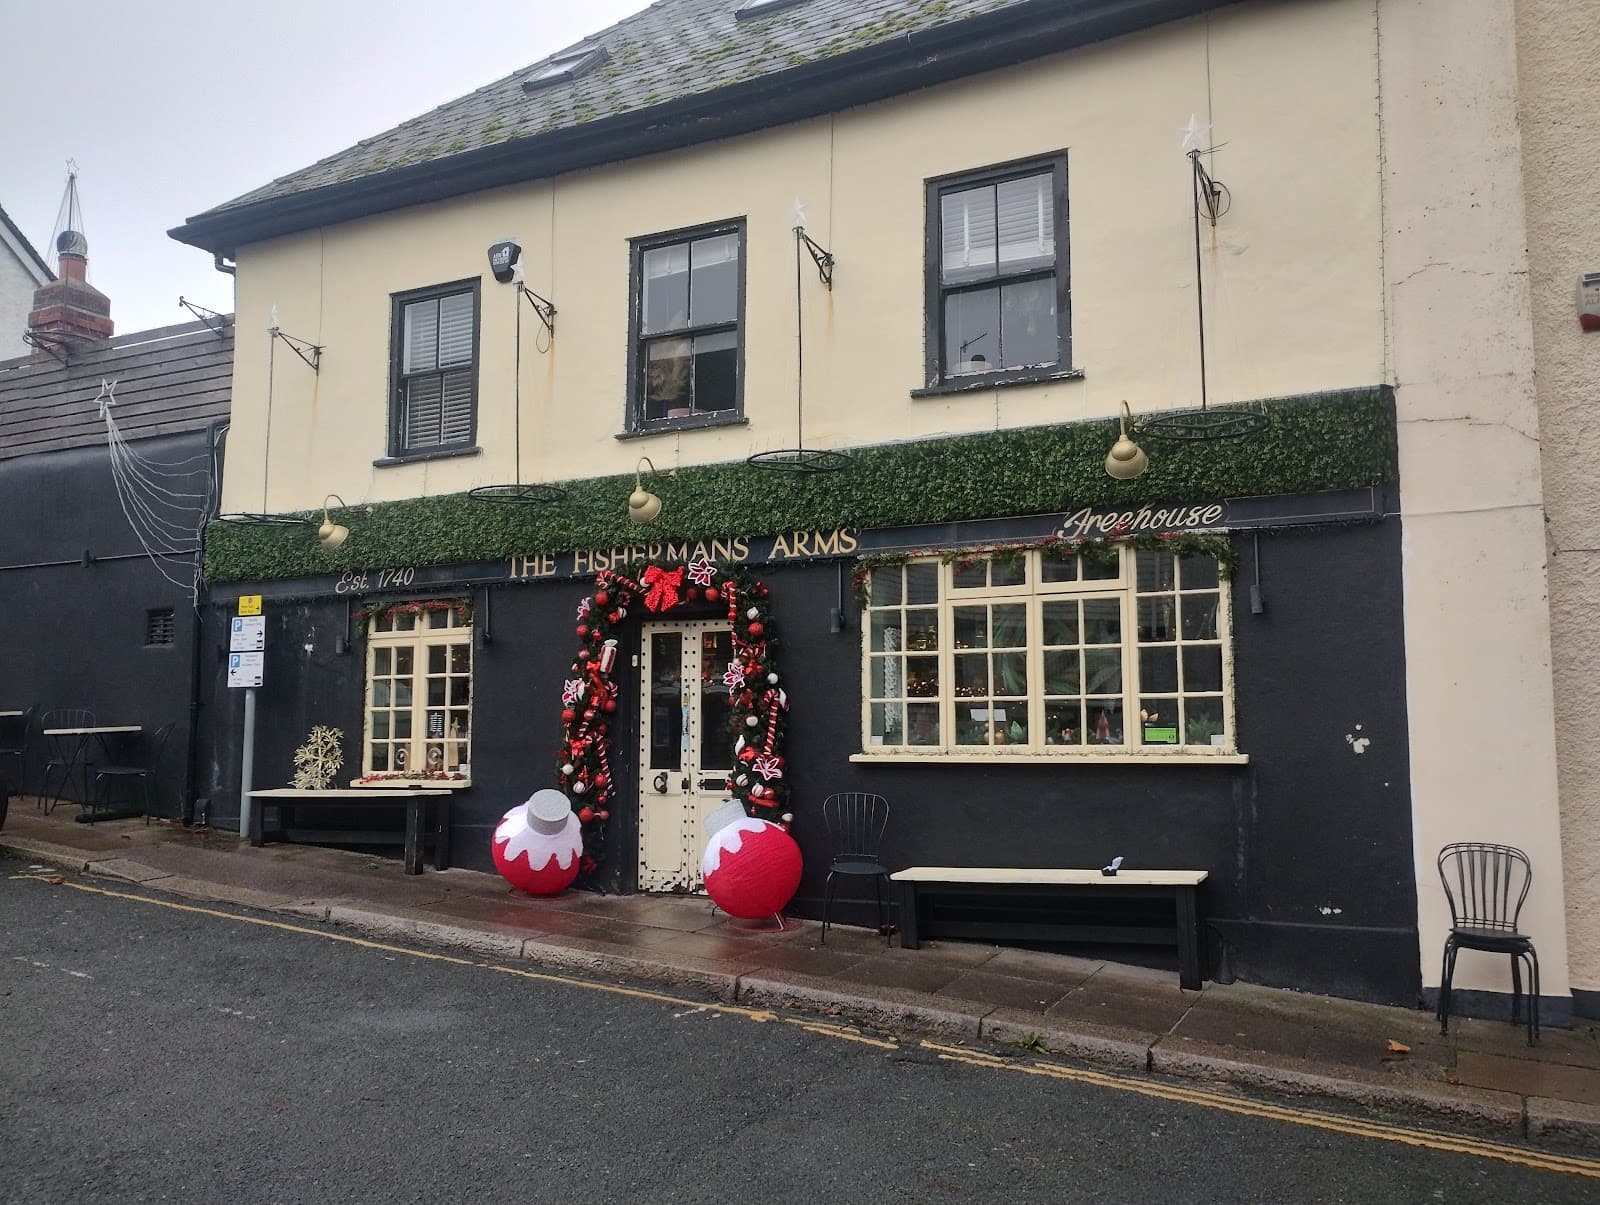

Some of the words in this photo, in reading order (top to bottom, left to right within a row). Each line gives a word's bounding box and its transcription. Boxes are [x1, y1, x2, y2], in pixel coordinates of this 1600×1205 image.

[507, 552, 557, 578] THE
[572, 535, 749, 574] FISHERMANS
[768, 527, 857, 559] ARMS
[335, 570, 369, 593] Est.
[379, 567, 414, 588] 1740
